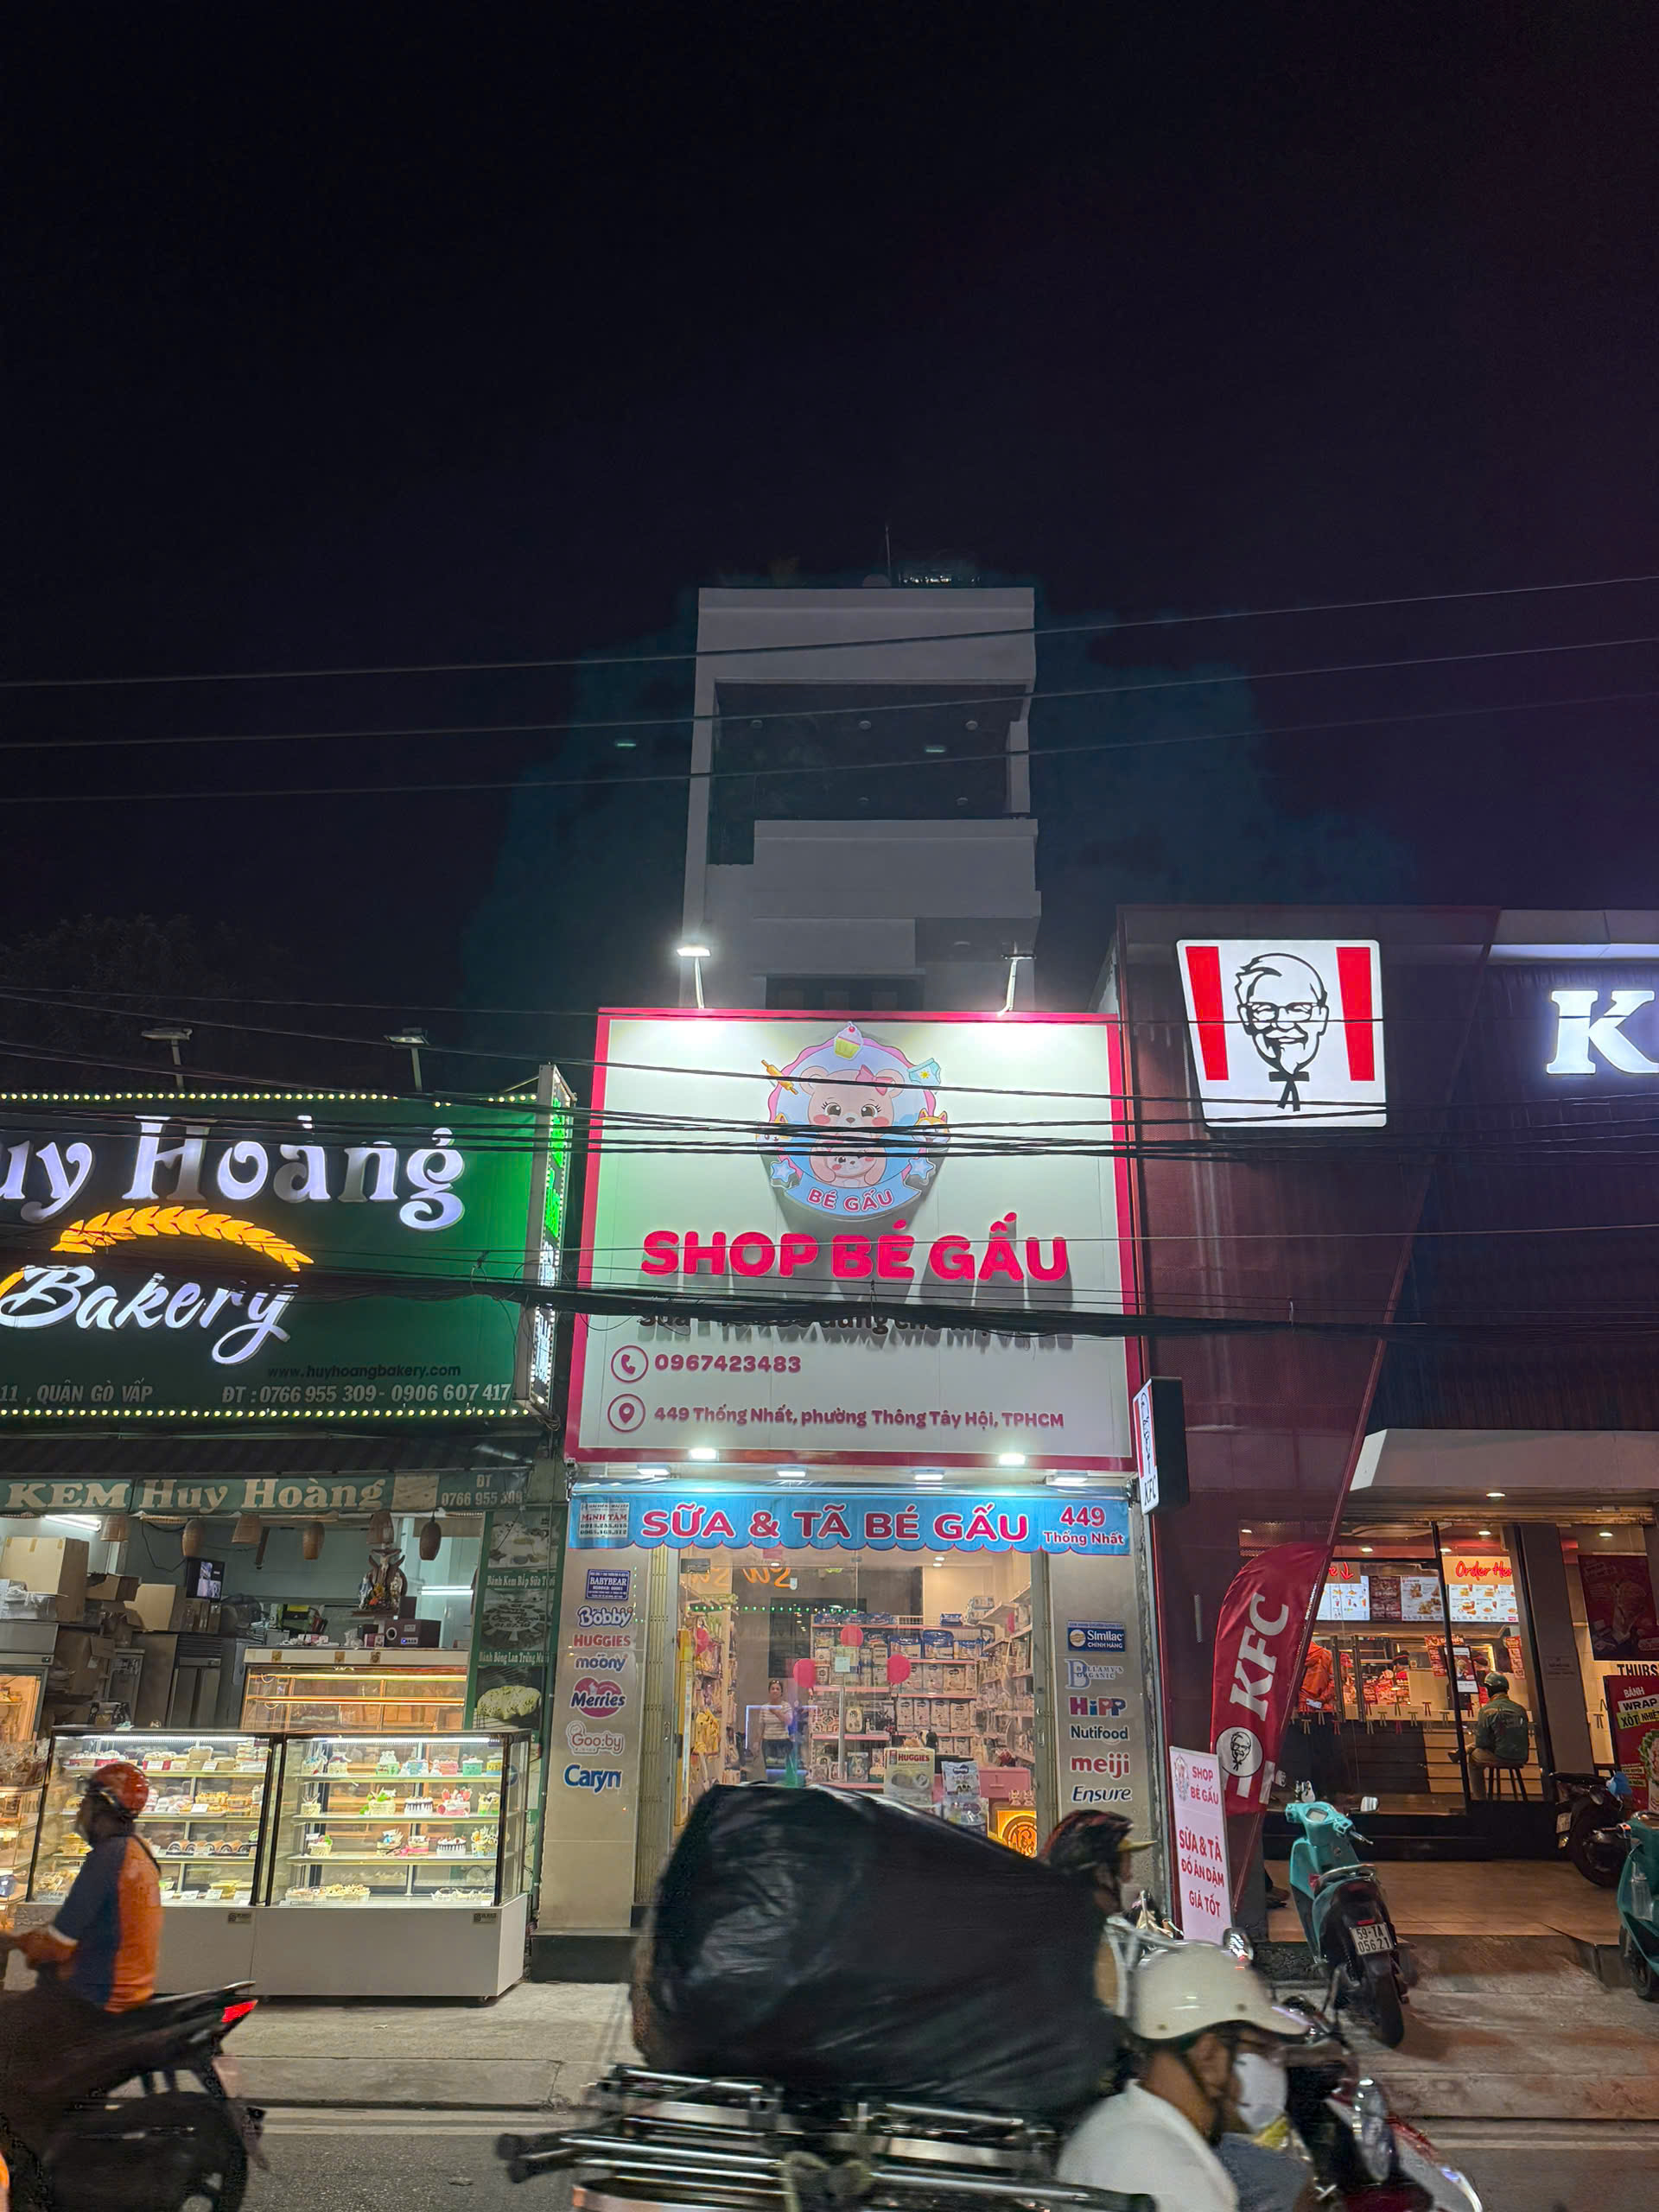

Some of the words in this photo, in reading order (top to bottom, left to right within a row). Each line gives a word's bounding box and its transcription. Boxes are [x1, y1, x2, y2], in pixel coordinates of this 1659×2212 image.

[1547, 990, 1659, 1075] K
[121, 1116, 465, 1230] Hoàng
[808, 1188, 836, 1209] BÉ
[843, 1188, 893, 1211] GẤU
[640, 1230, 819, 1277] SHOP
[832, 1219, 915, 1280] BÉ
[929, 1211, 1069, 1282] GẤU
[0, 1265, 291, 1365] Bakery
[268, 1364, 461, 1380] www.huyhoangbakery.com
[654, 1354, 801, 1373] 0967423483
[36, 1380, 84, 1406] QUẬN
[91, 1381, 116, 1402] GÒ
[122, 1378, 153, 1402] VẤP
[260, 1386, 302, 1402] 0766
[305, 1386, 337, 1402] 955
[391, 1384, 437, 1402] 0906
[442, 1384, 479, 1402] 607
[482, 1384, 512, 1402] 417
[654, 1407, 690, 1421] 449
[693, 1404, 747, 1426] Thống
[751, 1404, 798, 1425] Nhất,
[801, 1408, 867, 1427] phường
[871, 1409, 927, 1429] Thông
[929, 1410, 962, 1429] Tây
[965, 1410, 999, 1430] Hội,
[1001, 1412, 1065, 1427] TPHCM
[4, 1483, 130, 1508] KEM
[139, 1479, 228, 1513] Huy
[241, 1478, 385, 1510] Hoàng
[442, 1492, 471, 1506] 0766
[475, 1492, 498, 1506] 955
[500, 1491, 523, 1505] 309
[1144, 1474, 1157, 1506] KFC
[641, 1501, 735, 1539] SỮA
[749, 1510, 781, 1539] &
[792, 1503, 851, 1539] TÃ
[864, 1503, 920, 1541] BÉ
[933, 1502, 1029, 1541] GẤU
[1059, 1506, 1106, 1527] 449
[1043, 1530, 1087, 1546] Thống
[1090, 1532, 1124, 1545] Nhất
[1455, 1560, 1491, 1581] Order
[1492, 1560, 1512, 1578] Her
[589, 1577, 627, 1586] BABYBEAR
[577, 1605, 634, 1629] Bobby
[574, 1634, 631, 1647] HUGGIES
[1087, 1630, 1123, 1641] Similac
[575, 1654, 629, 1671] moony
[1229, 1592, 1289, 1721] KFC
[1617, 1664, 1659, 1676] THURS
[571, 1692, 626, 1707] Merries
[1070, 1697, 1127, 1716] HiPP
[1623, 1698, 1658, 1711] WRAP
[1071, 1726, 1128, 1739] Nutifood
[898, 1753, 930, 1762] HUGGIES
[1071, 1753, 1129, 1778] meiji
[564, 1764, 622, 1793] Caryn
[1192, 1766, 1213, 1782] SHOP
[1072, 1786, 1131, 1802] Ensure
[1202, 1785, 1219, 1804] GẤU
